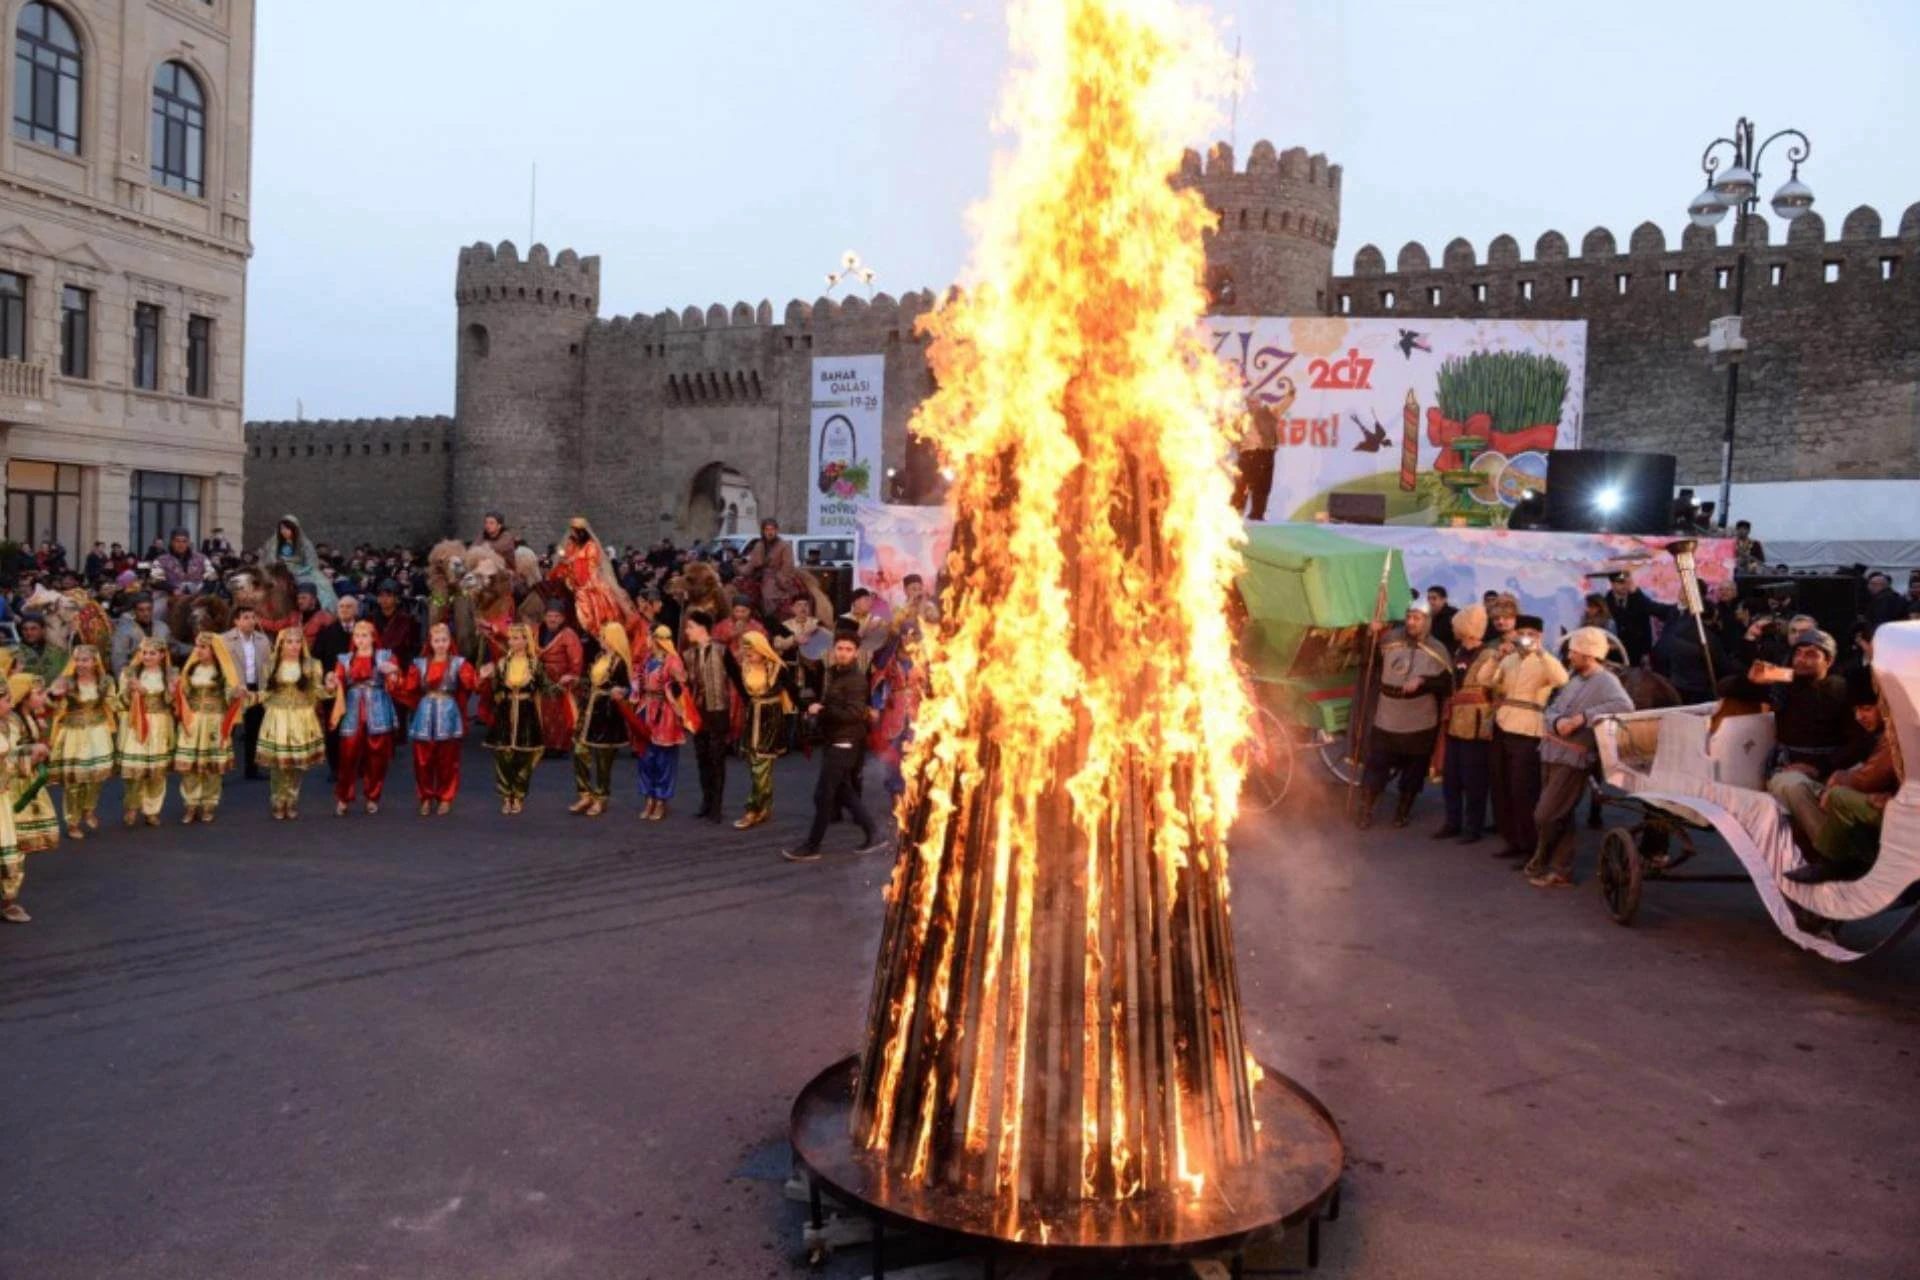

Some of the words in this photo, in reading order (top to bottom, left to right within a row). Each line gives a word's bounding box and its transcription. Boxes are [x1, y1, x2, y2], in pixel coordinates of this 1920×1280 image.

[1308, 348, 1374, 389] 2017
[821, 370, 857, 382] BAHAR
[820, 503, 858, 514] NOVRU
